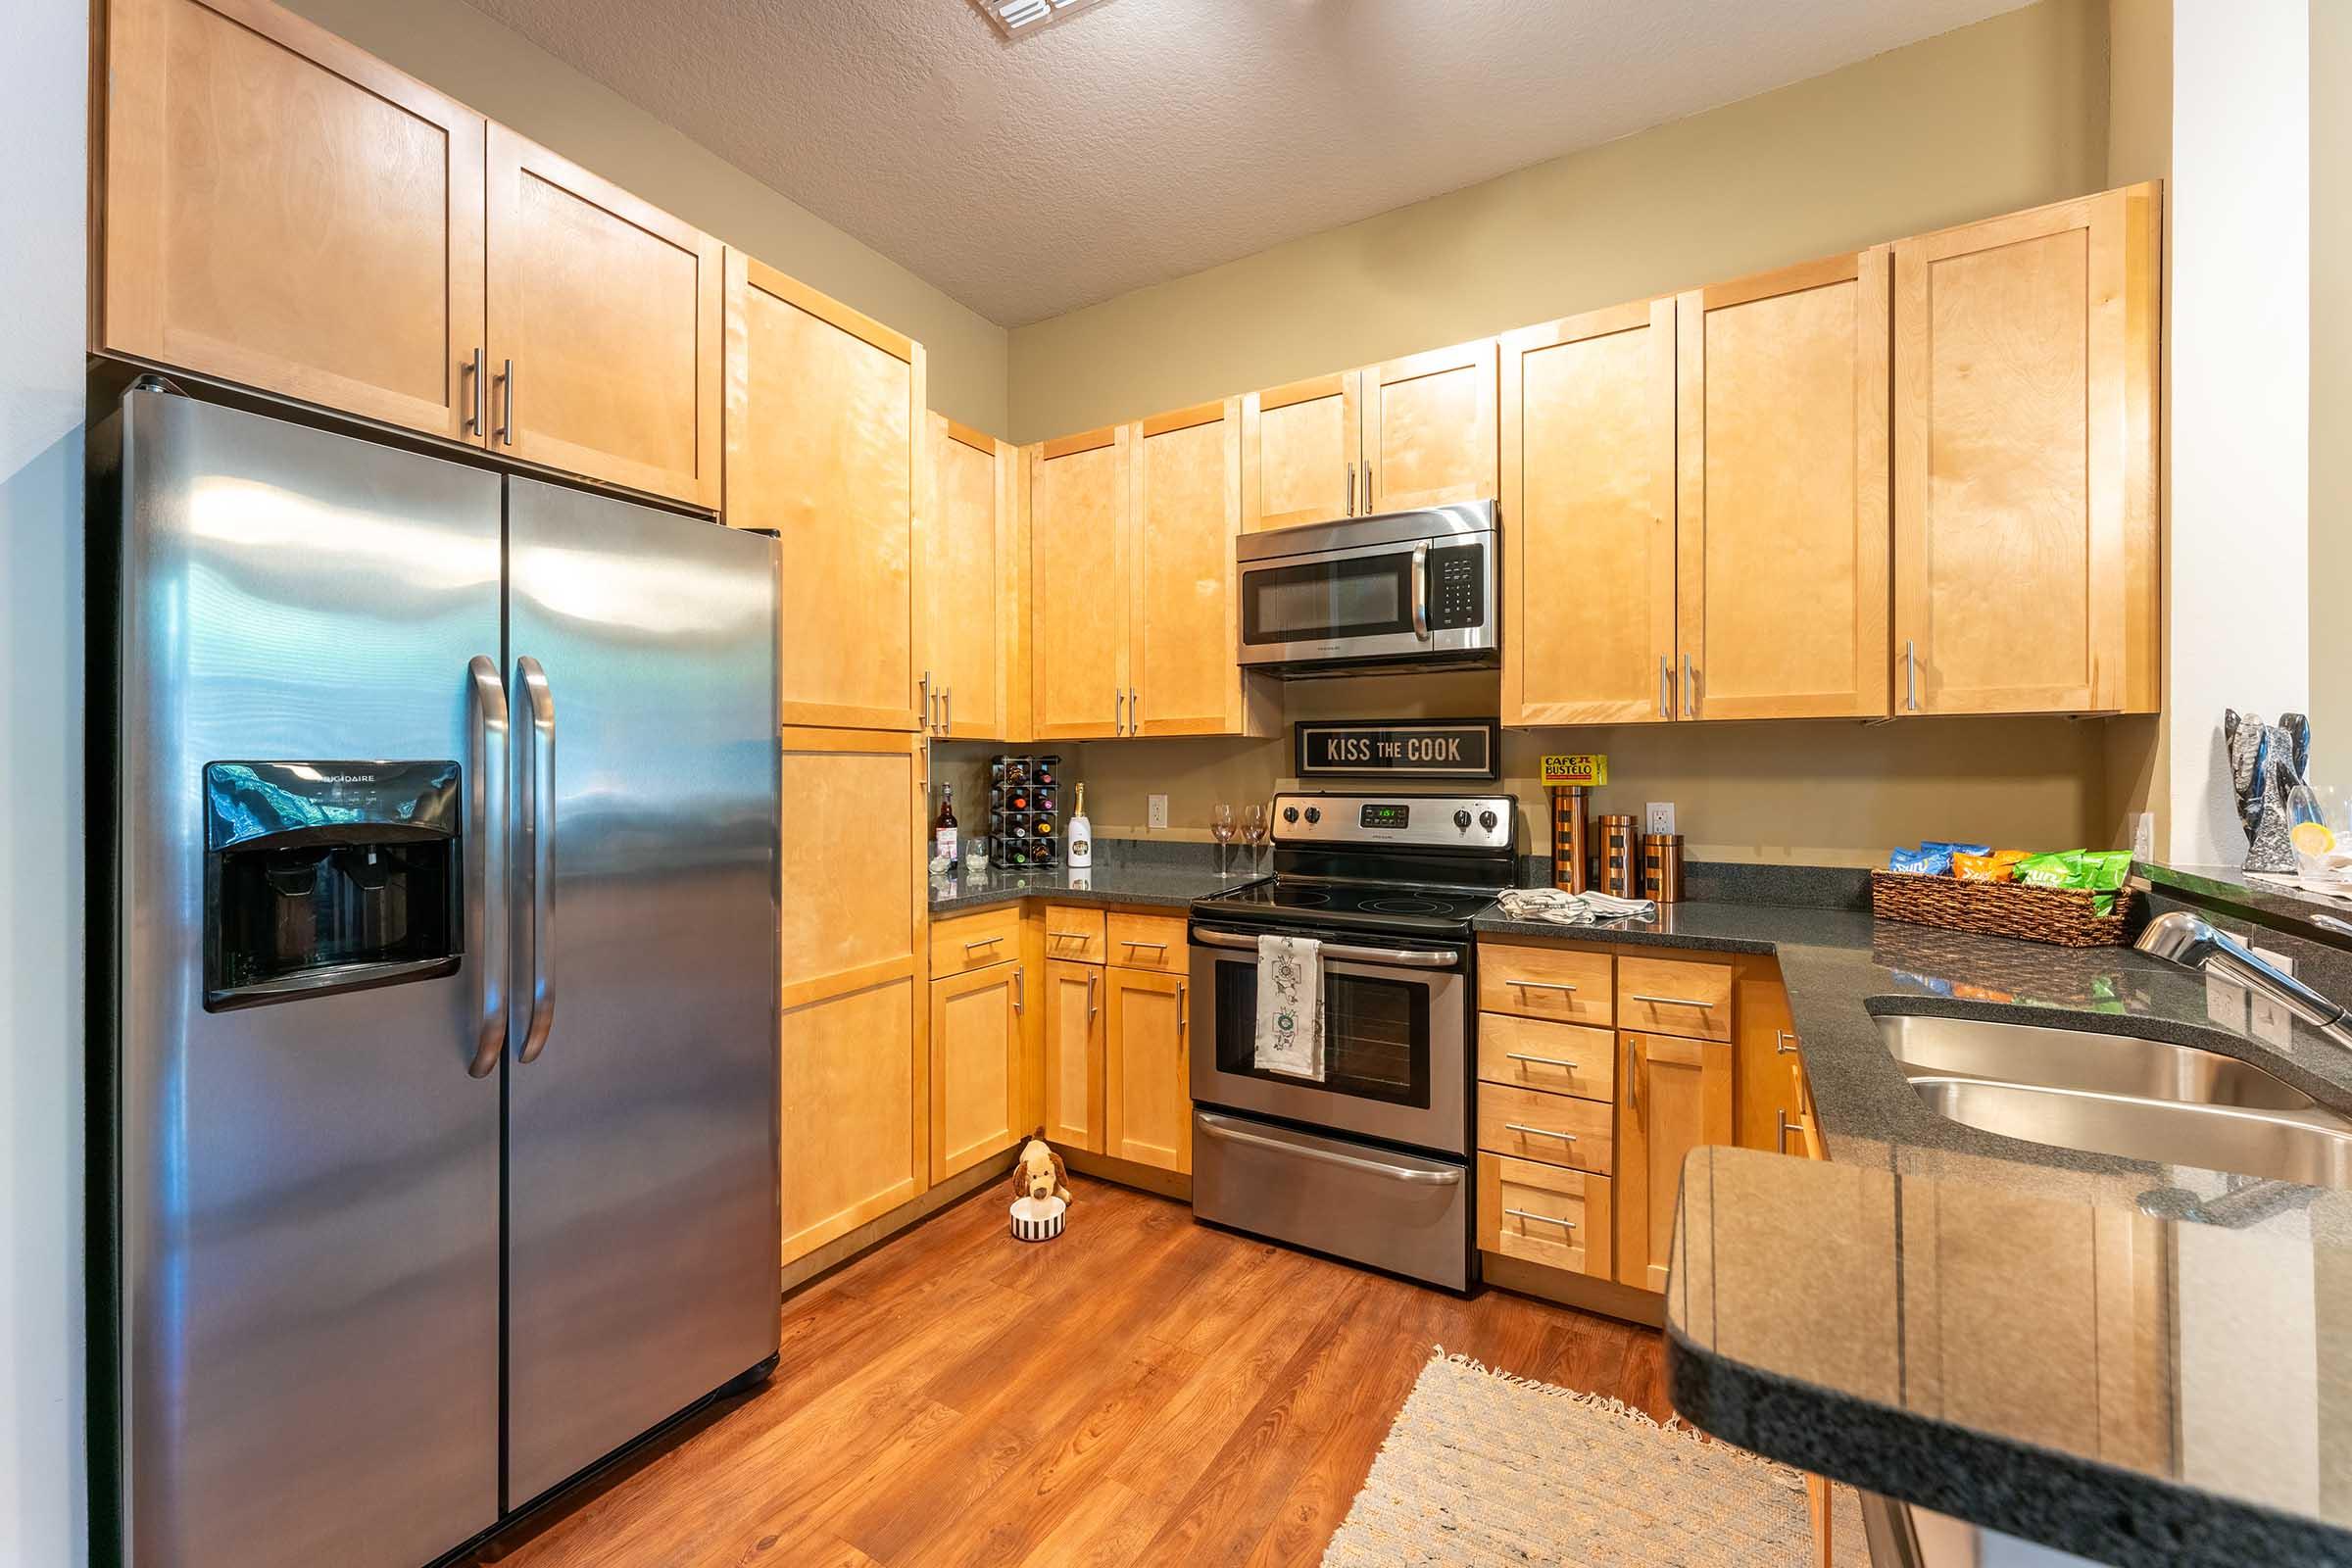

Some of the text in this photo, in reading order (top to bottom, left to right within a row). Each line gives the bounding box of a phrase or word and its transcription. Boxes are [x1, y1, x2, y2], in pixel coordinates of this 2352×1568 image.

[1328, 738, 1460, 760] KISS THE COOK
[1545, 765, 1592, 774] BUSTELO
